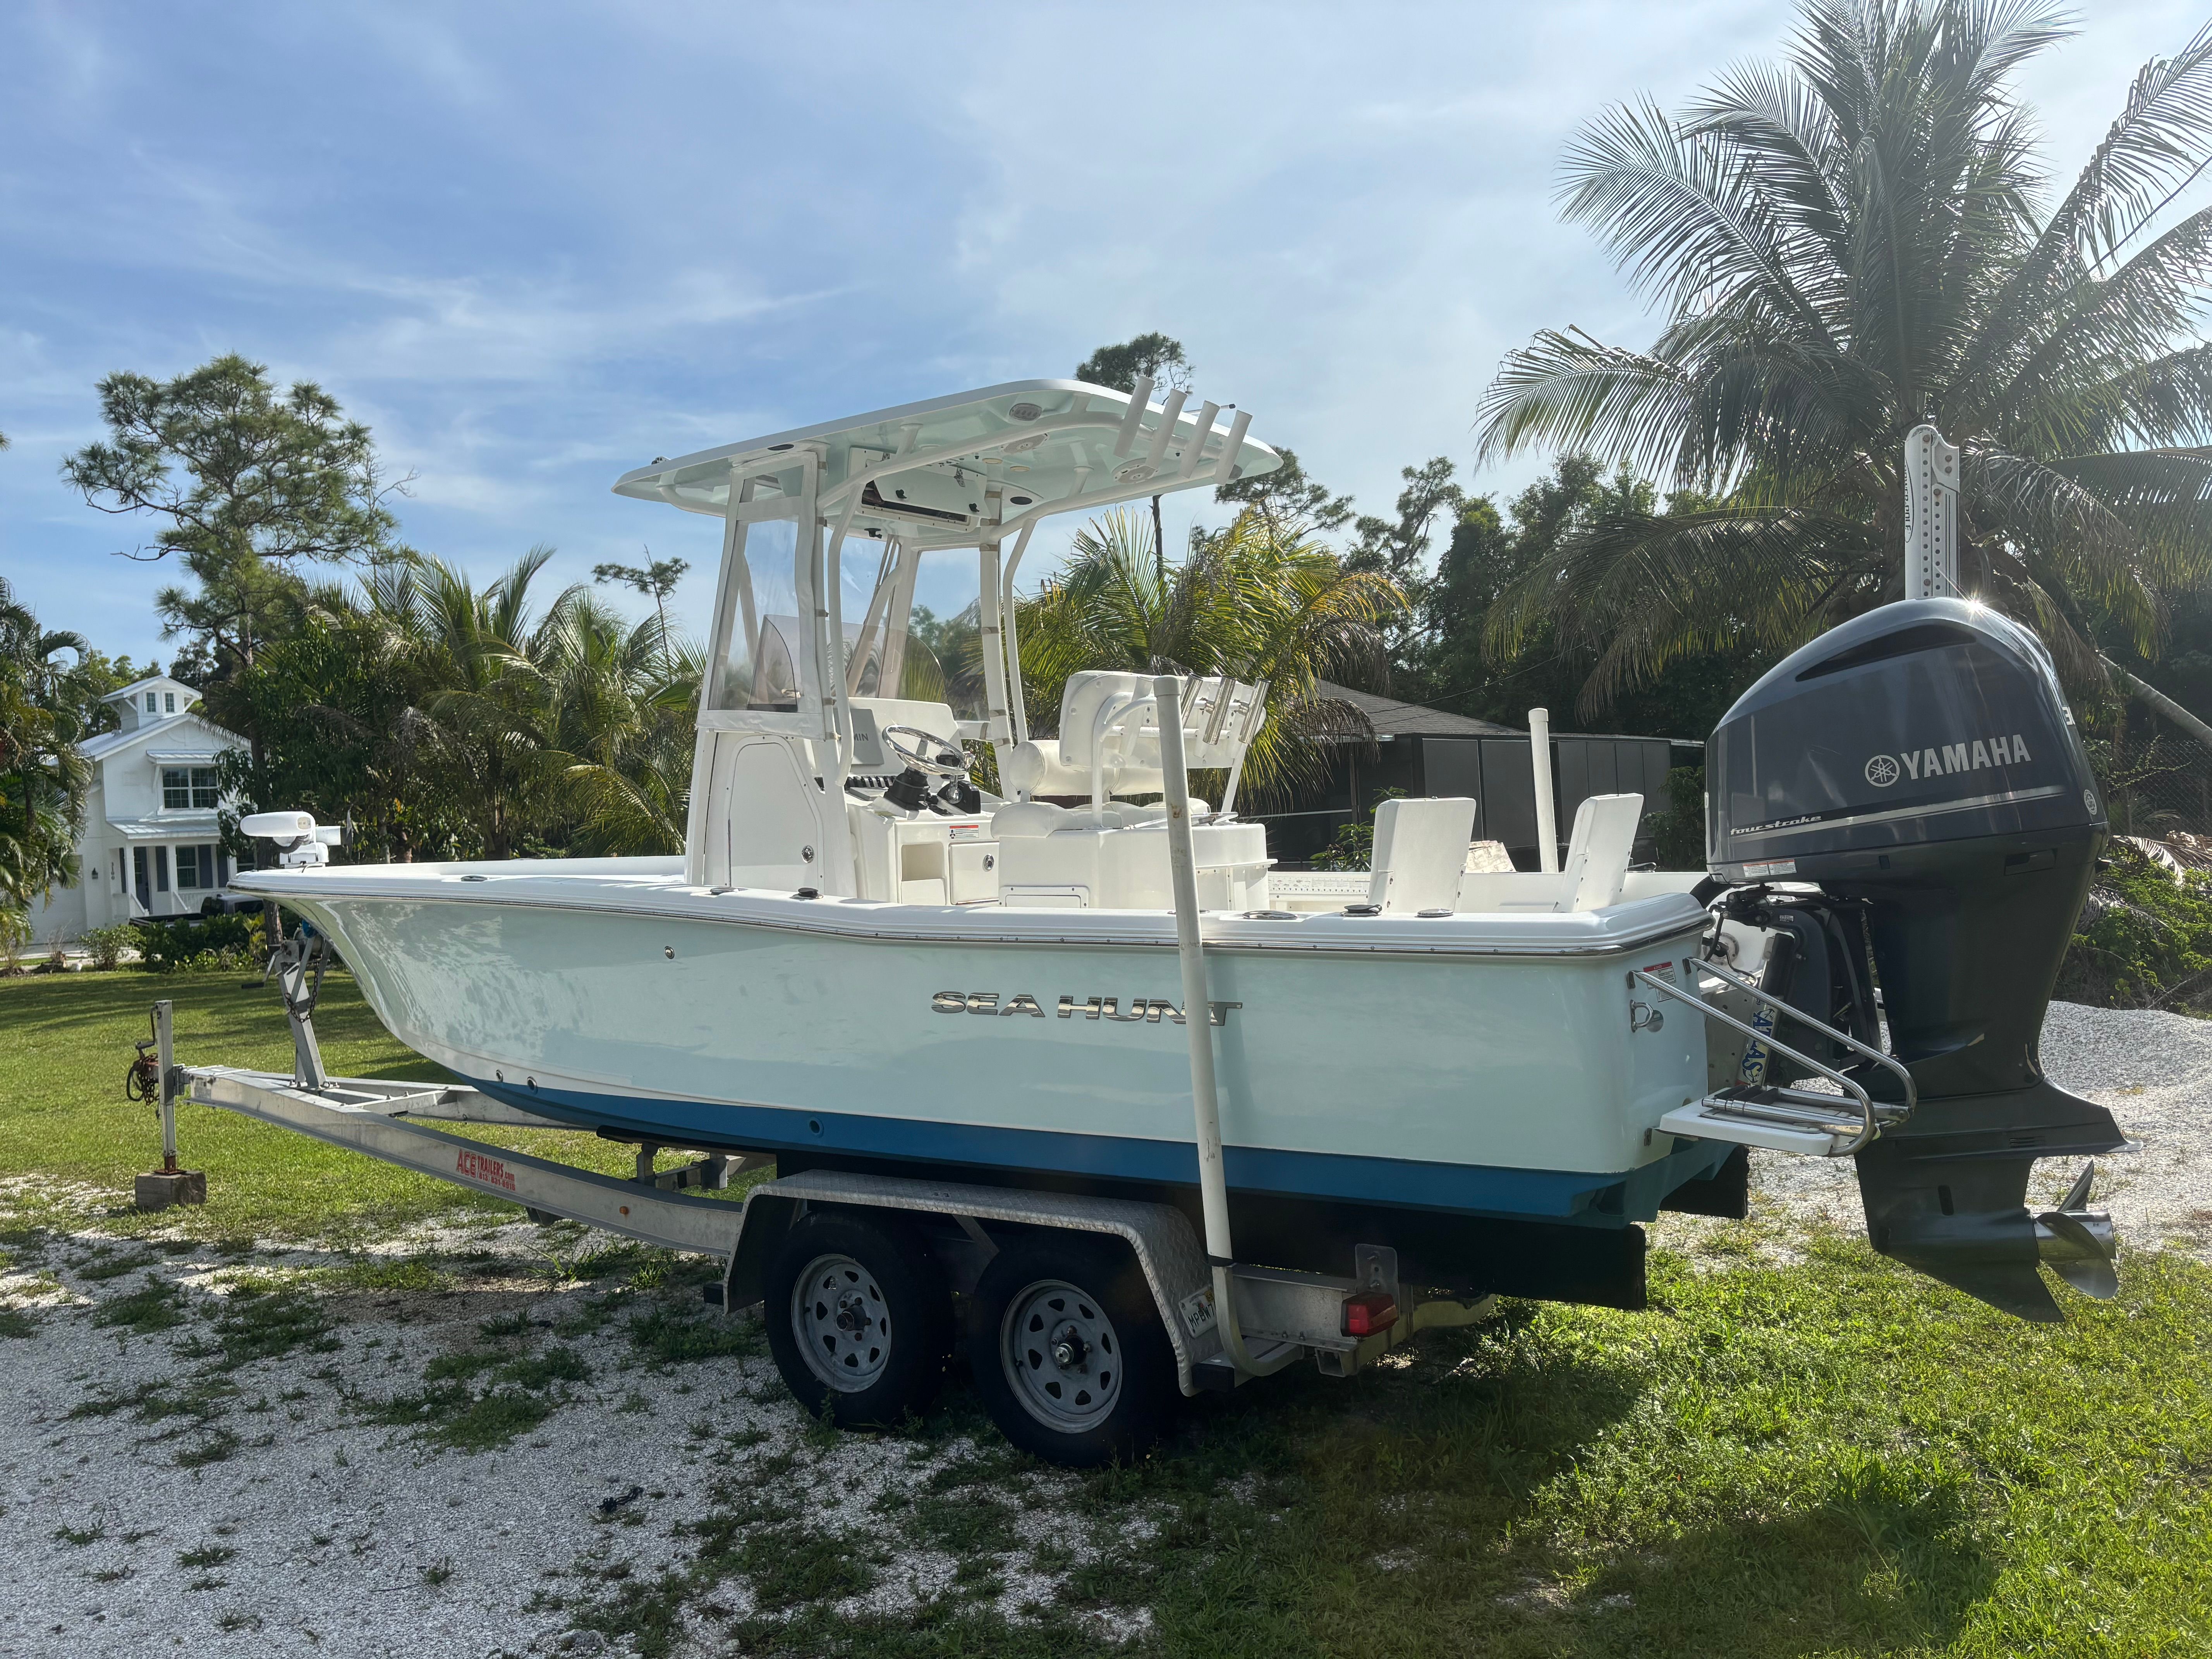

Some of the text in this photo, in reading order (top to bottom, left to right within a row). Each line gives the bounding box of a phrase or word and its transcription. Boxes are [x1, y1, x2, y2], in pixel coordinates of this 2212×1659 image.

[854, 733, 869, 741] MIN
[1900, 734, 2032, 780] YAMAHA
[931, 991, 1243, 1026] SEA HUNT
[456, 1149, 477, 1178] ACE
[477, 1170, 490, 1182] (813)
[1188, 1302, 1216, 1328] MPBW7
